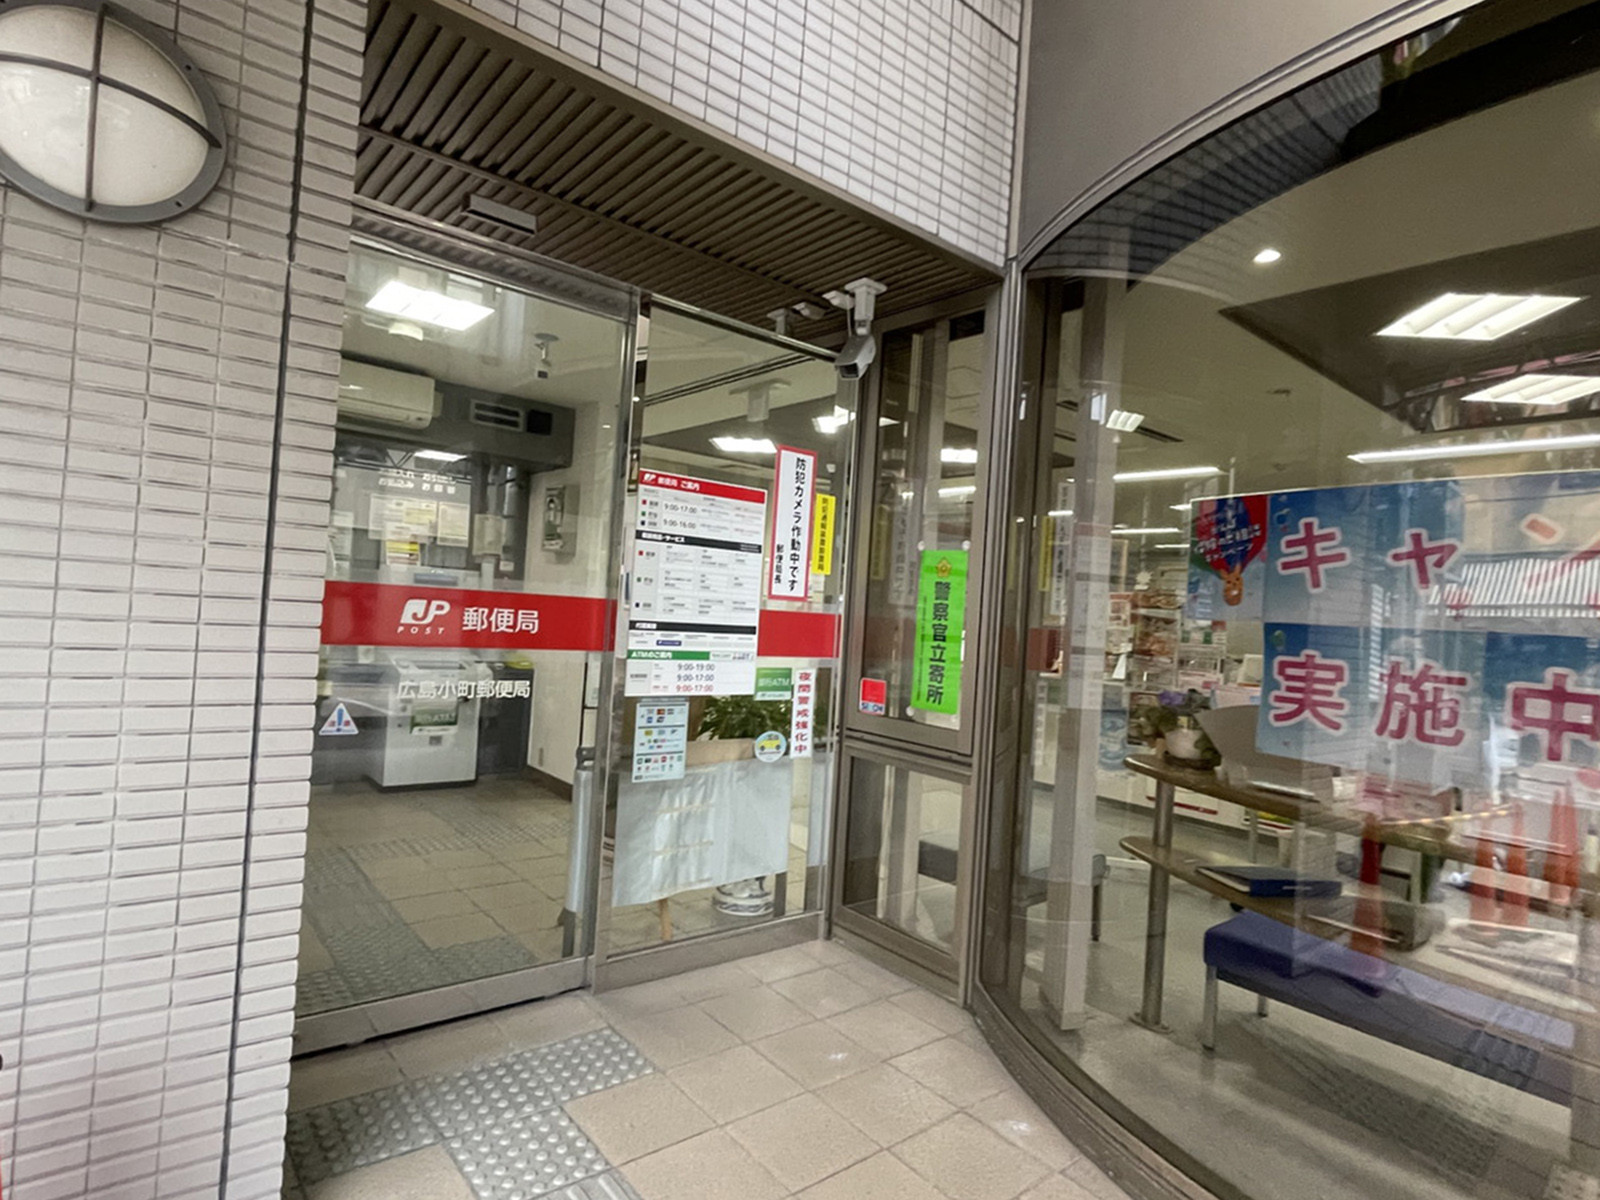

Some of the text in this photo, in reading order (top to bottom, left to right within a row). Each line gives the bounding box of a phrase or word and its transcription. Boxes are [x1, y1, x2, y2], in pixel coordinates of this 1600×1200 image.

[788, 457, 807, 592] 防犯カメラ作動中です
[774, 544, 785, 584] 郵便局長
[396, 625, 445, 635] POST
[462, 606, 539, 634] 郵便局
[925, 581, 952, 706] 警察官立寄所
[676, 673, 715, 682] 9:00-17:00
[677, 662, 716, 672] 9:00-19:00
[398, 680, 531, 699] 広島小町郵便局
[675, 684, 714, 693] 9:00-17:00
[794, 672, 812, 754] 夜間警戒強化中
[1271, 652, 1600, 762] 実施中
